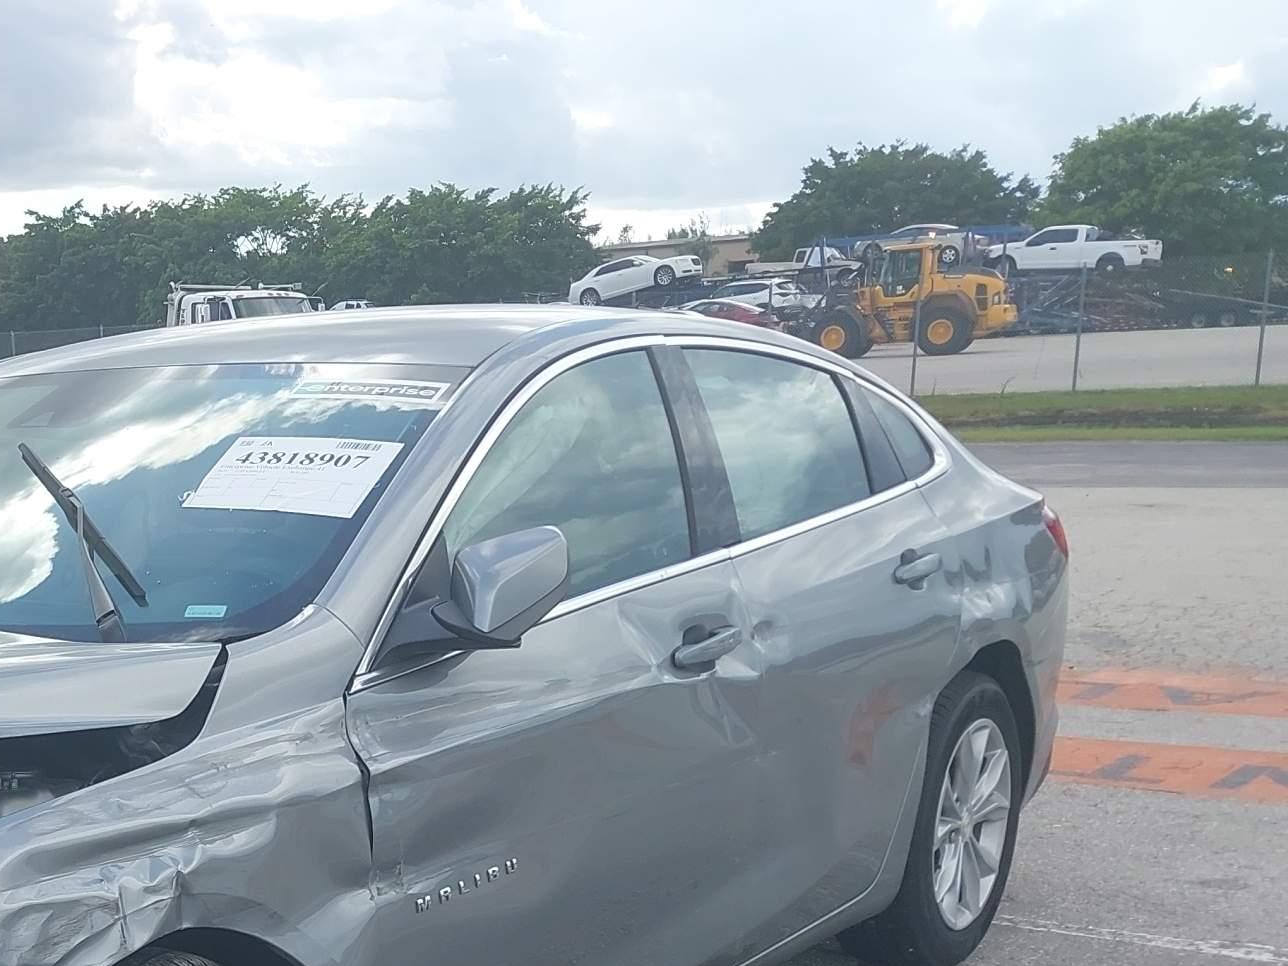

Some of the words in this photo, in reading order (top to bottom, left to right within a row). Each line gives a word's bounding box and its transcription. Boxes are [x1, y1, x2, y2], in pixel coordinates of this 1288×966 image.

[302, 382, 436, 397] enterprise
[235, 451, 372, 469] 43818907
[415, 858, 518, 913] MALIBU
